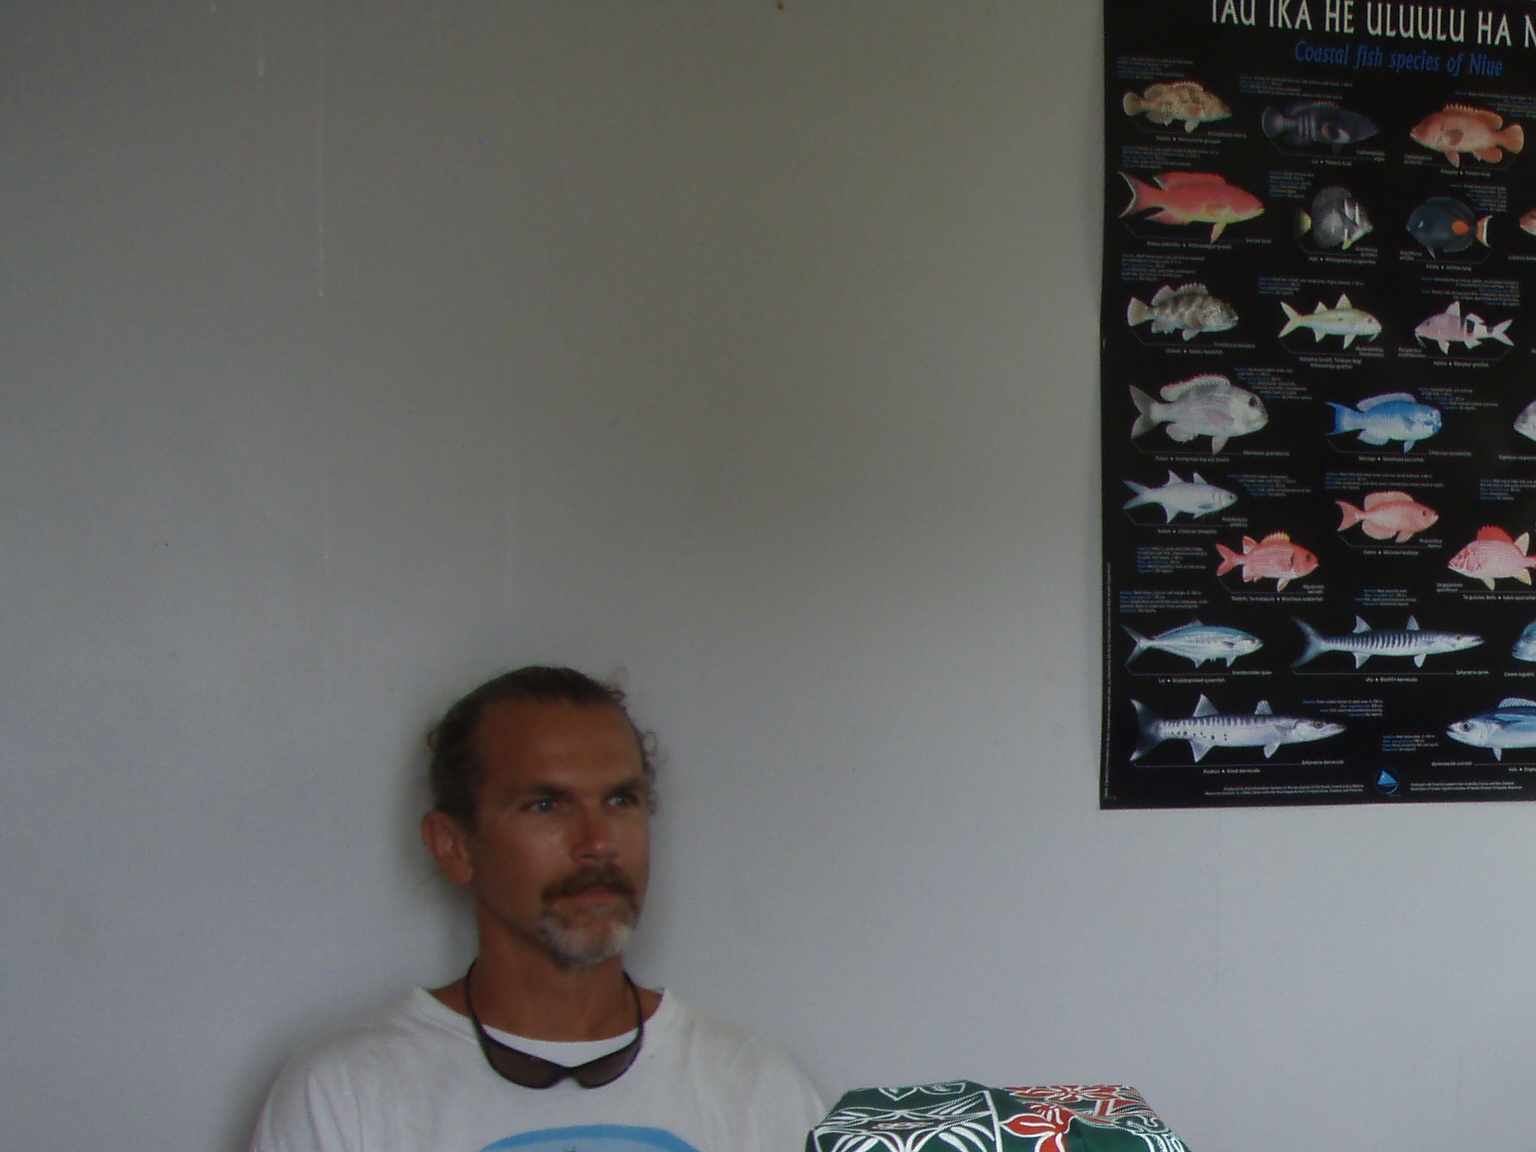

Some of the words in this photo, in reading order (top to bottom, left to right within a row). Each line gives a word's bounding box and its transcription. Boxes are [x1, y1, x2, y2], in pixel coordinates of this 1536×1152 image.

[1269, 0, 1313, 31] IKA
[1325, 0, 1356, 34] HE
[1366, 2, 1466, 44] ULUULU
[1477, 10, 1513, 48] HA
[1294, 40, 1349, 66] Coastal
[1354, 45, 1383, 71] fish
[1389, 49, 1440, 74] species
[1446, 53, 1465, 77] of
[1469, 55, 1504, 77] Niue
